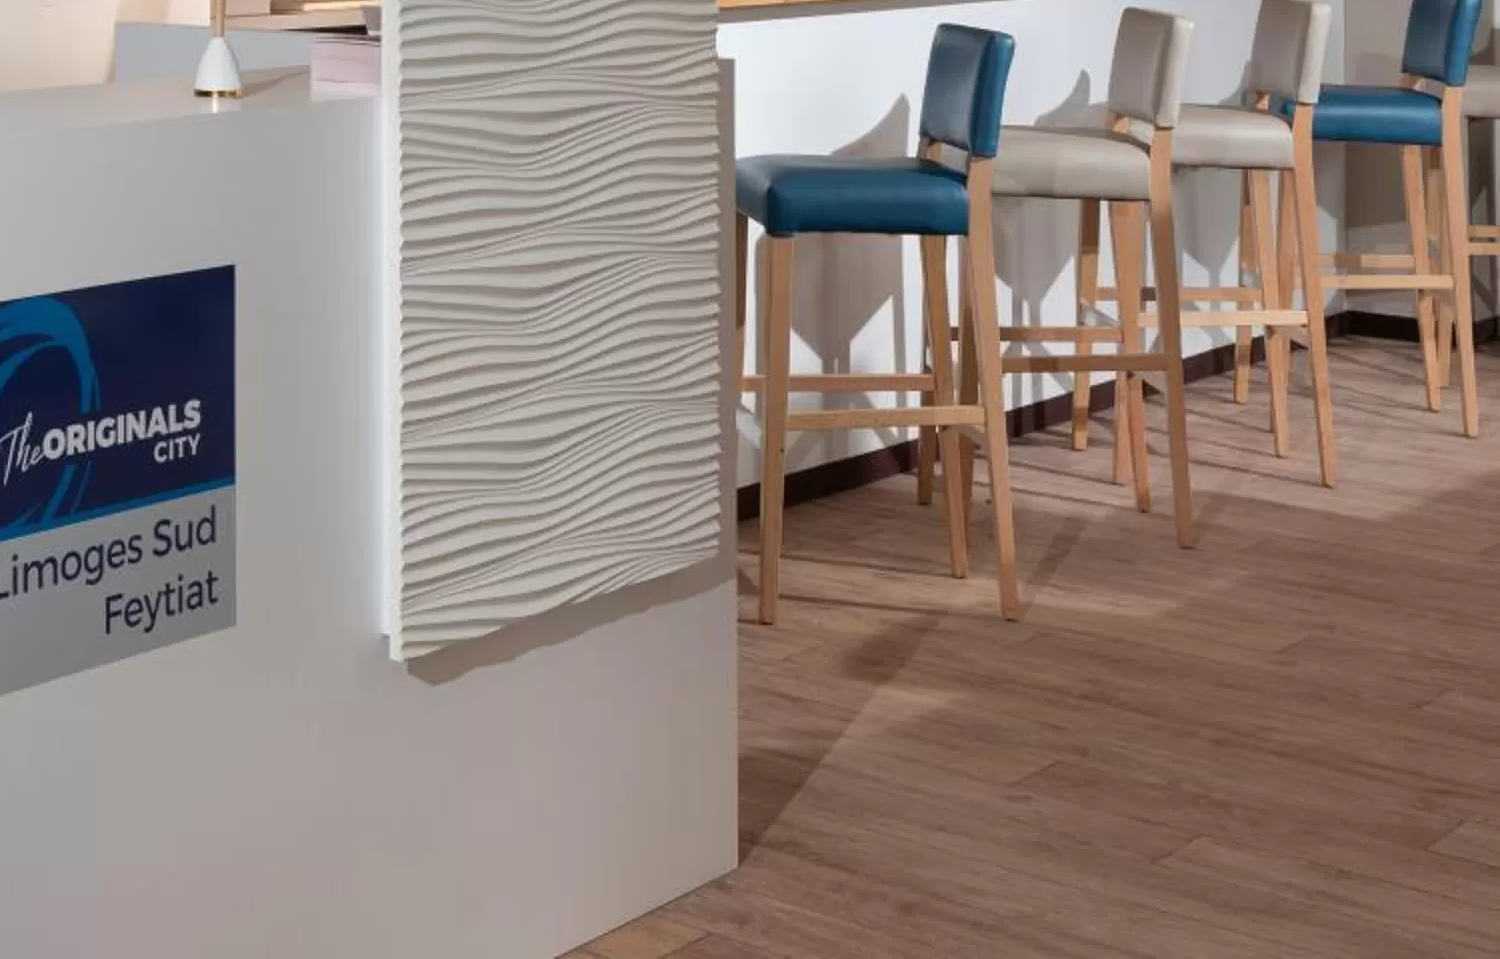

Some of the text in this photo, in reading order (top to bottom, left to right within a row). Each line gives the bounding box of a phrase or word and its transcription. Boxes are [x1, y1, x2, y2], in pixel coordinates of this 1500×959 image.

[42, 398, 202, 461] ORIGINALS
[153, 433, 201, 464] CITY
[152, 504, 218, 557] Sud
[105, 569, 219, 635] Feytiat
